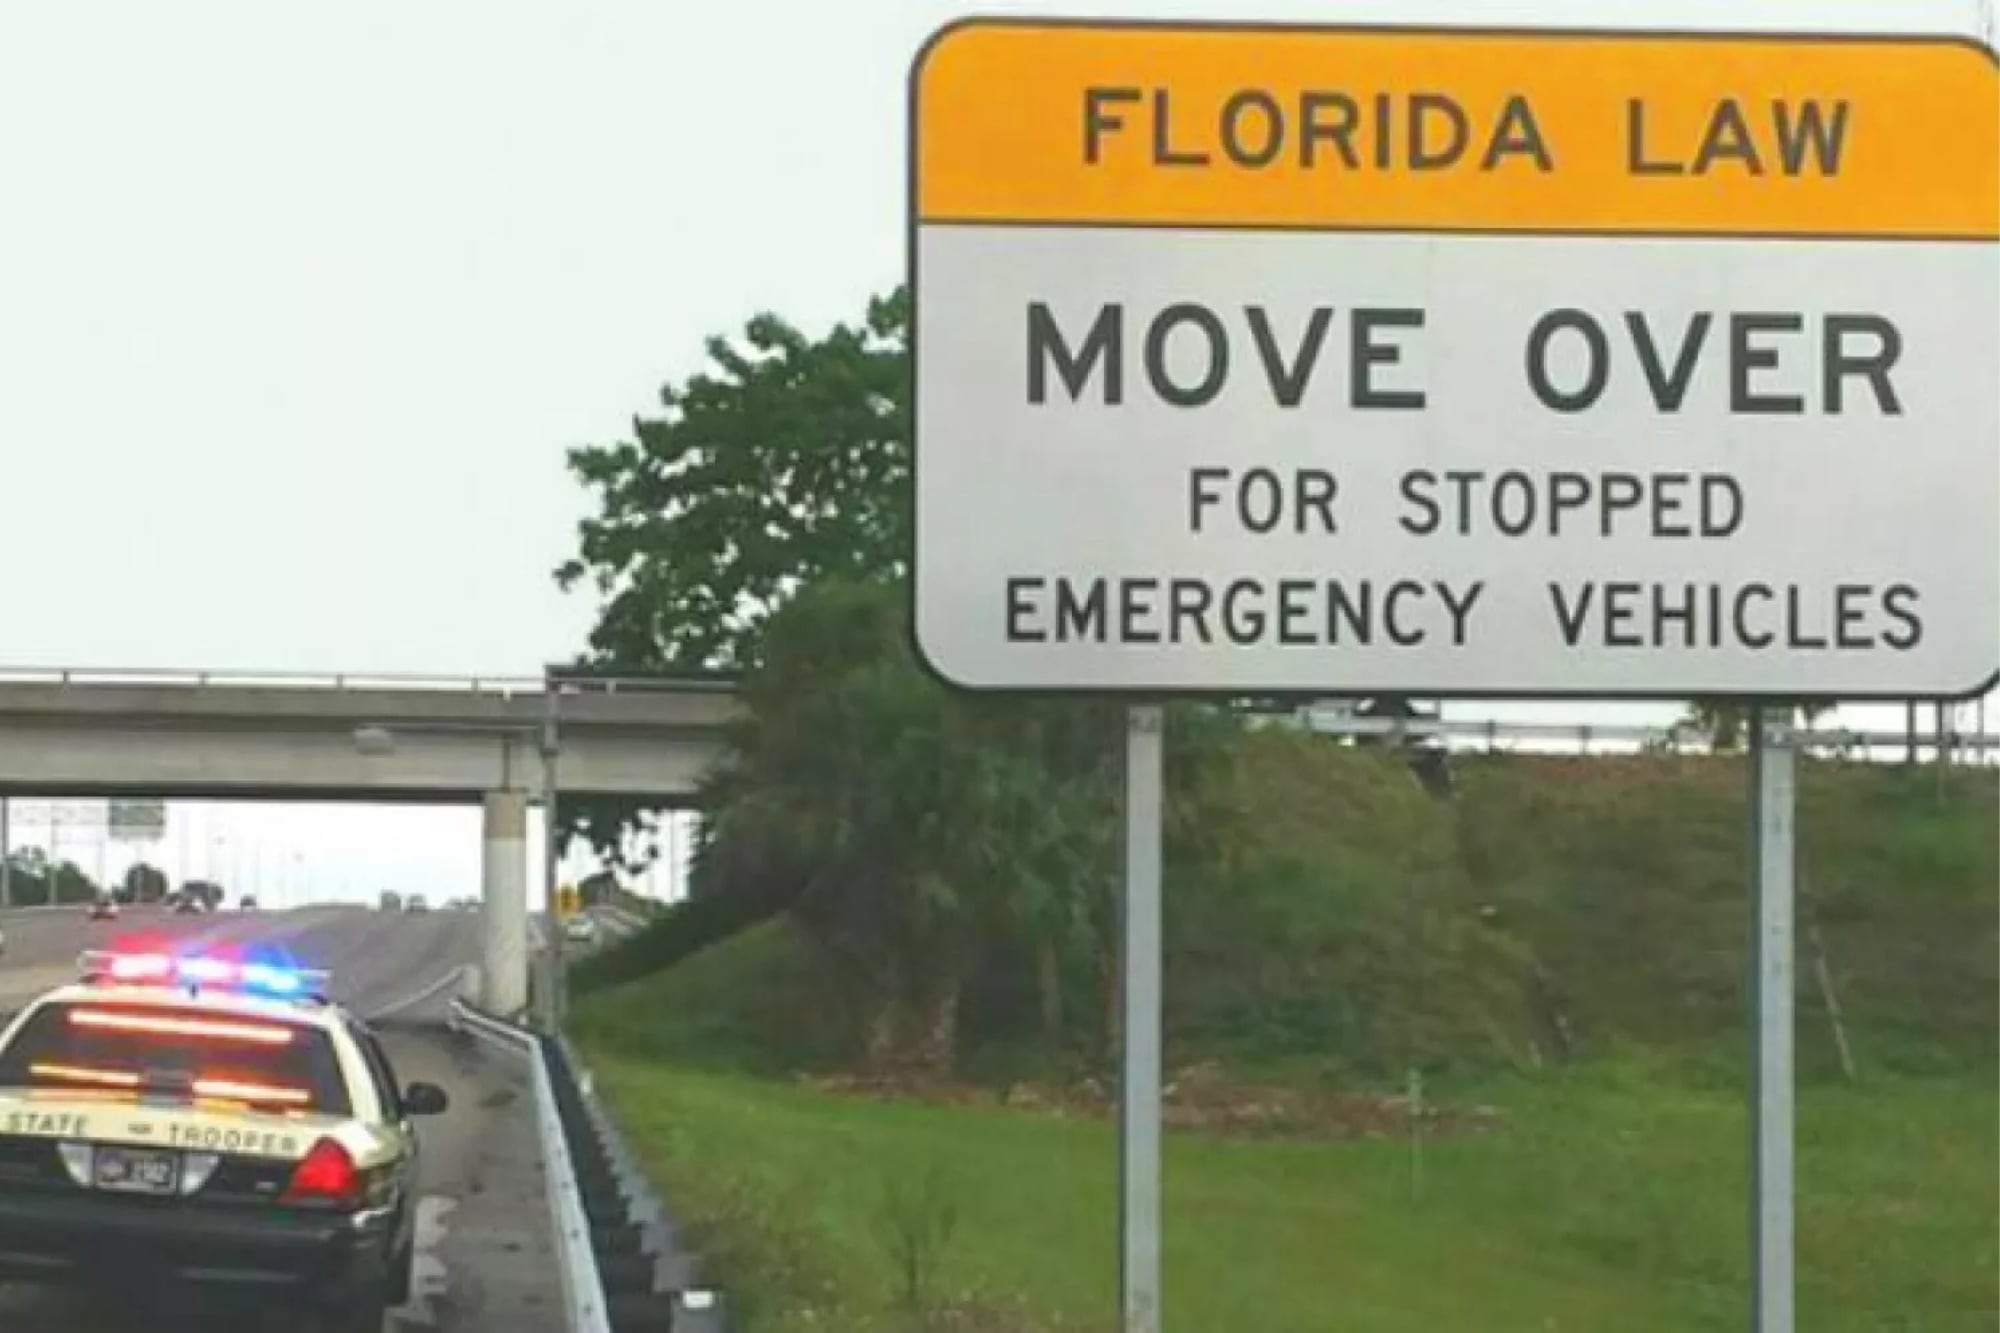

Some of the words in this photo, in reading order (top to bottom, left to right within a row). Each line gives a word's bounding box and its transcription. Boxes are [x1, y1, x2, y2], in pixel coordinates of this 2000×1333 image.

[1083, 86, 1554, 172] FLORIDA
[1628, 98, 1849, 177] LAW
[1026, 301, 1426, 410] MOVE
[1526, 308, 1902, 415] OVER
[1190, 467, 1337, 534] FOR
[1399, 469, 1744, 538] STOPPED
[1006, 577, 1484, 646] EMERGENCY
[1549, 582, 1922, 650] VEHICLES
[7, 1112, 88, 1137] STATE
[168, 1122, 298, 1153] TROOPER
